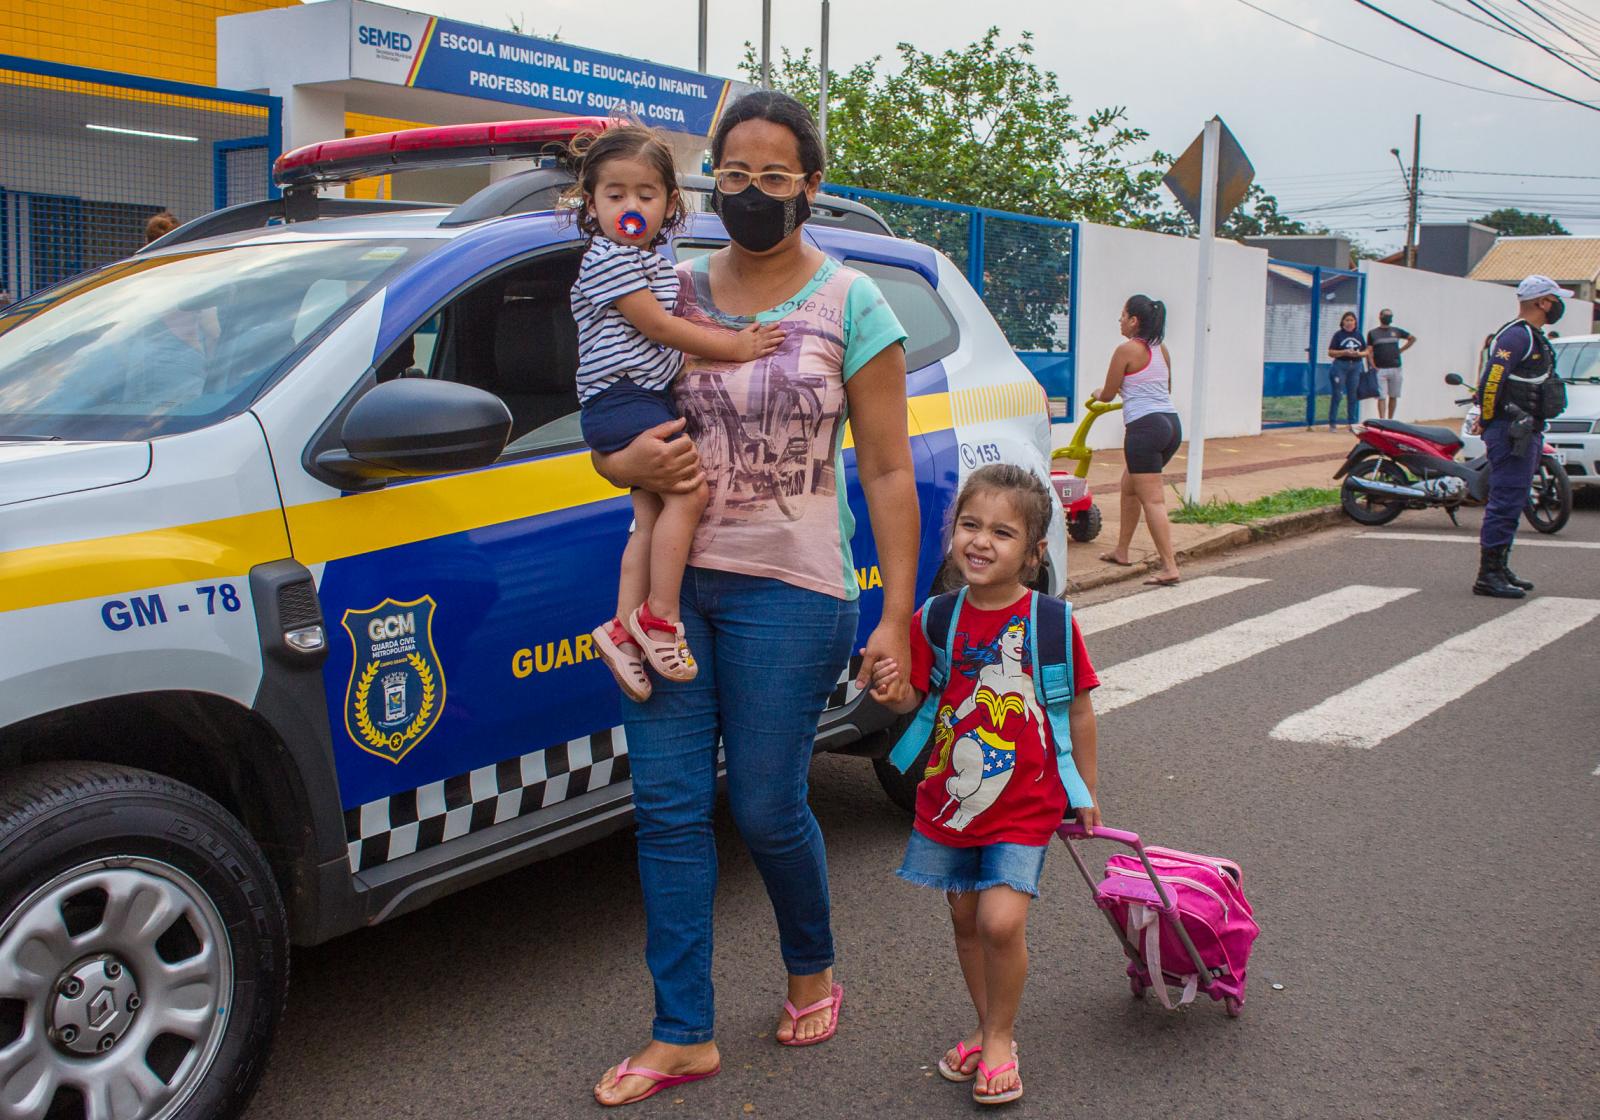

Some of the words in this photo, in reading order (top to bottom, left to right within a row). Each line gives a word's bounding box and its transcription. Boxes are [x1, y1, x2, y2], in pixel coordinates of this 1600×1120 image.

[358, 25, 412, 52] SEMED
[440, 32, 496, 57] ESCOLA
[499, 44, 570, 72] MUNICIPAL
[573, 59, 590, 76] DE
[593, 63, 656, 89] EDUCAÇÃO
[659, 77, 708, 99] INFANTIL
[470, 70, 549, 99] PROFESSOR
[552, 86, 584, 105] ELOY
[587, 92, 628, 112] SOUZA
[630, 101, 646, 116] DA
[648, 104, 685, 123] COSTA
[976, 443, 1000, 463] 153
[101, 594, 167, 631] GM
[196, 584, 241, 615] 78
[368, 611, 416, 641] GCM
[371, 640, 399, 651] GUARDA
[399, 637, 416, 646] CIVIL
[372, 644, 416, 658] METROPOLITANA
[512, 634, 600, 679] GUAR
